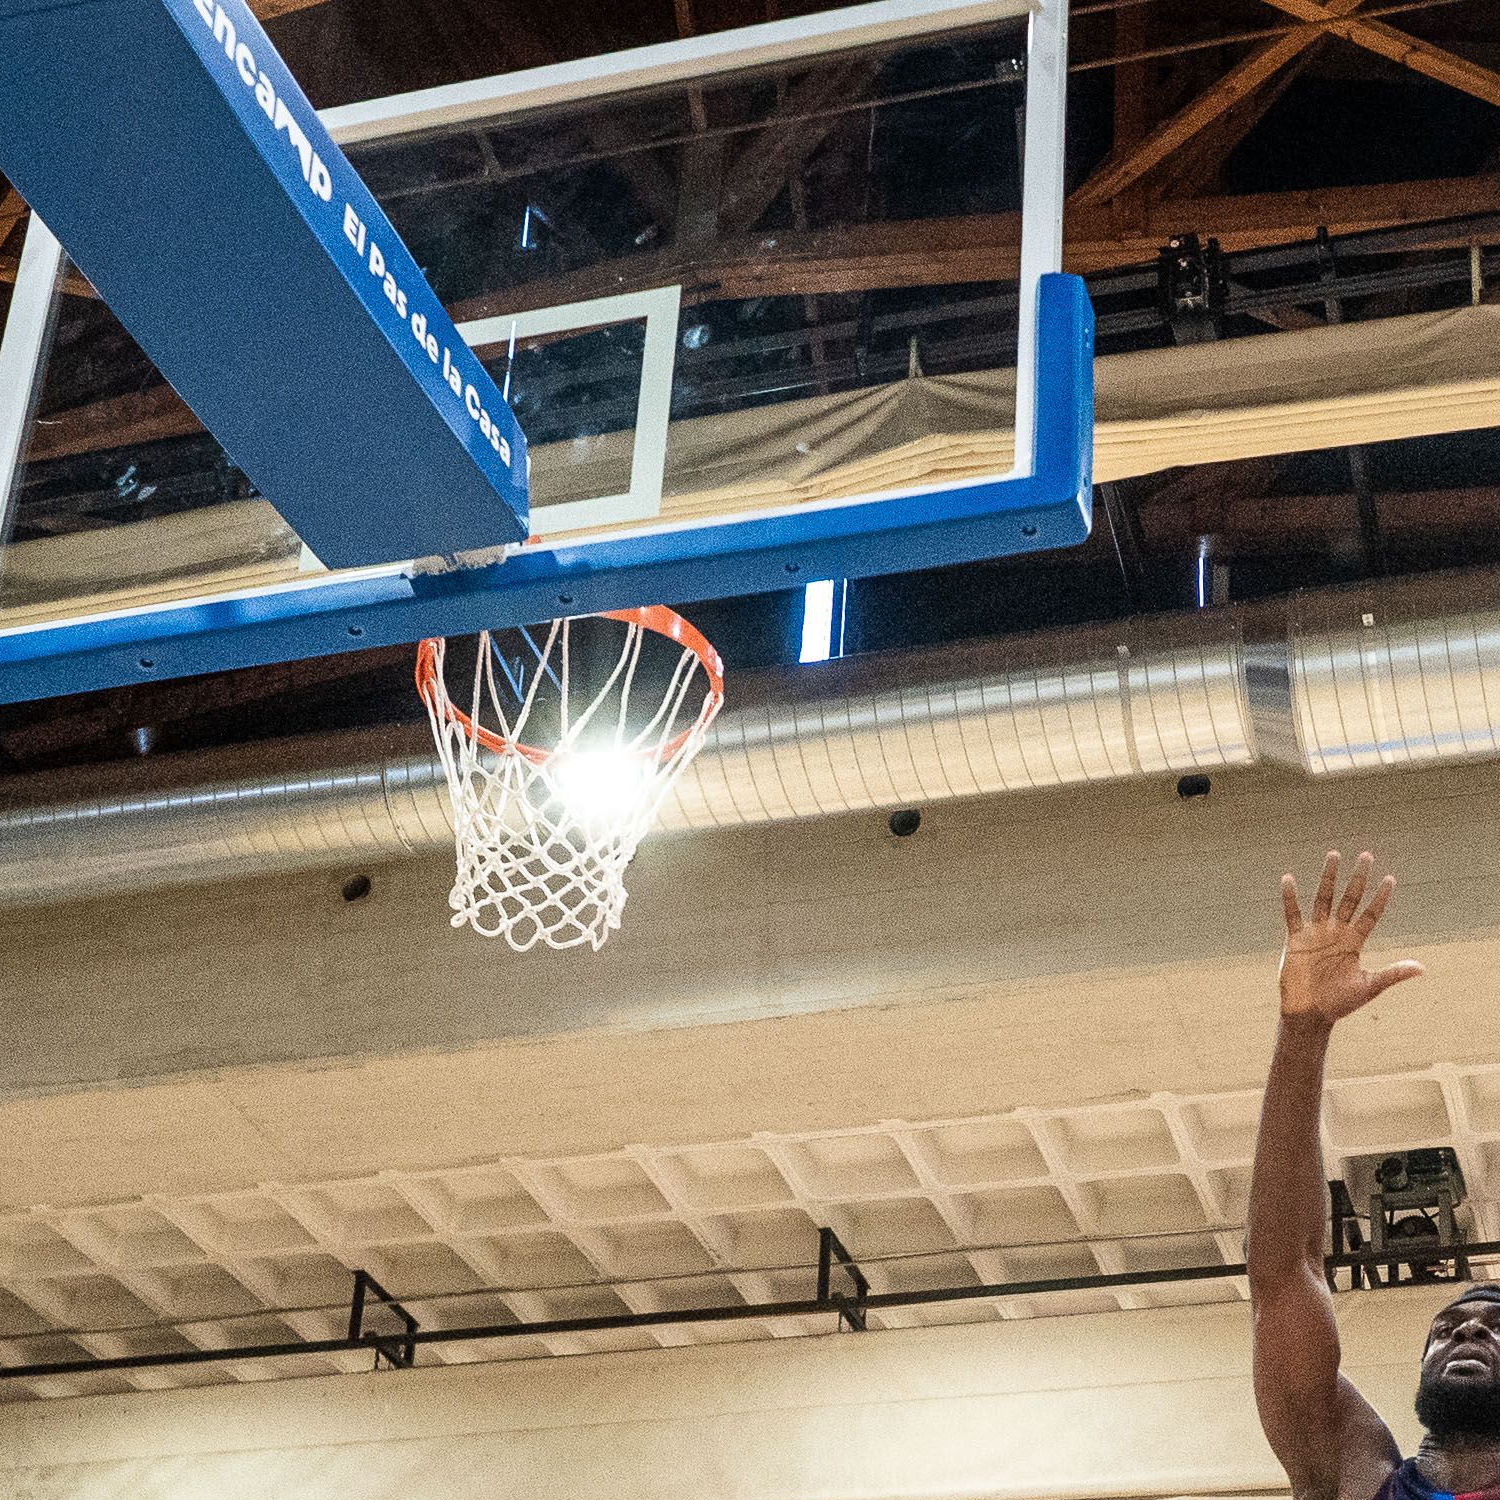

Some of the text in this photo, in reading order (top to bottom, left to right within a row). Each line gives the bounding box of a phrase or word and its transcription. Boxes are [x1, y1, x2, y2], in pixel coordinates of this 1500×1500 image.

[342, 202, 367, 257] El
[369, 241, 409, 320] Pas
[410, 311, 440, 365] de
[443, 346, 462, 399] la
[463, 382, 512, 468] Casa
